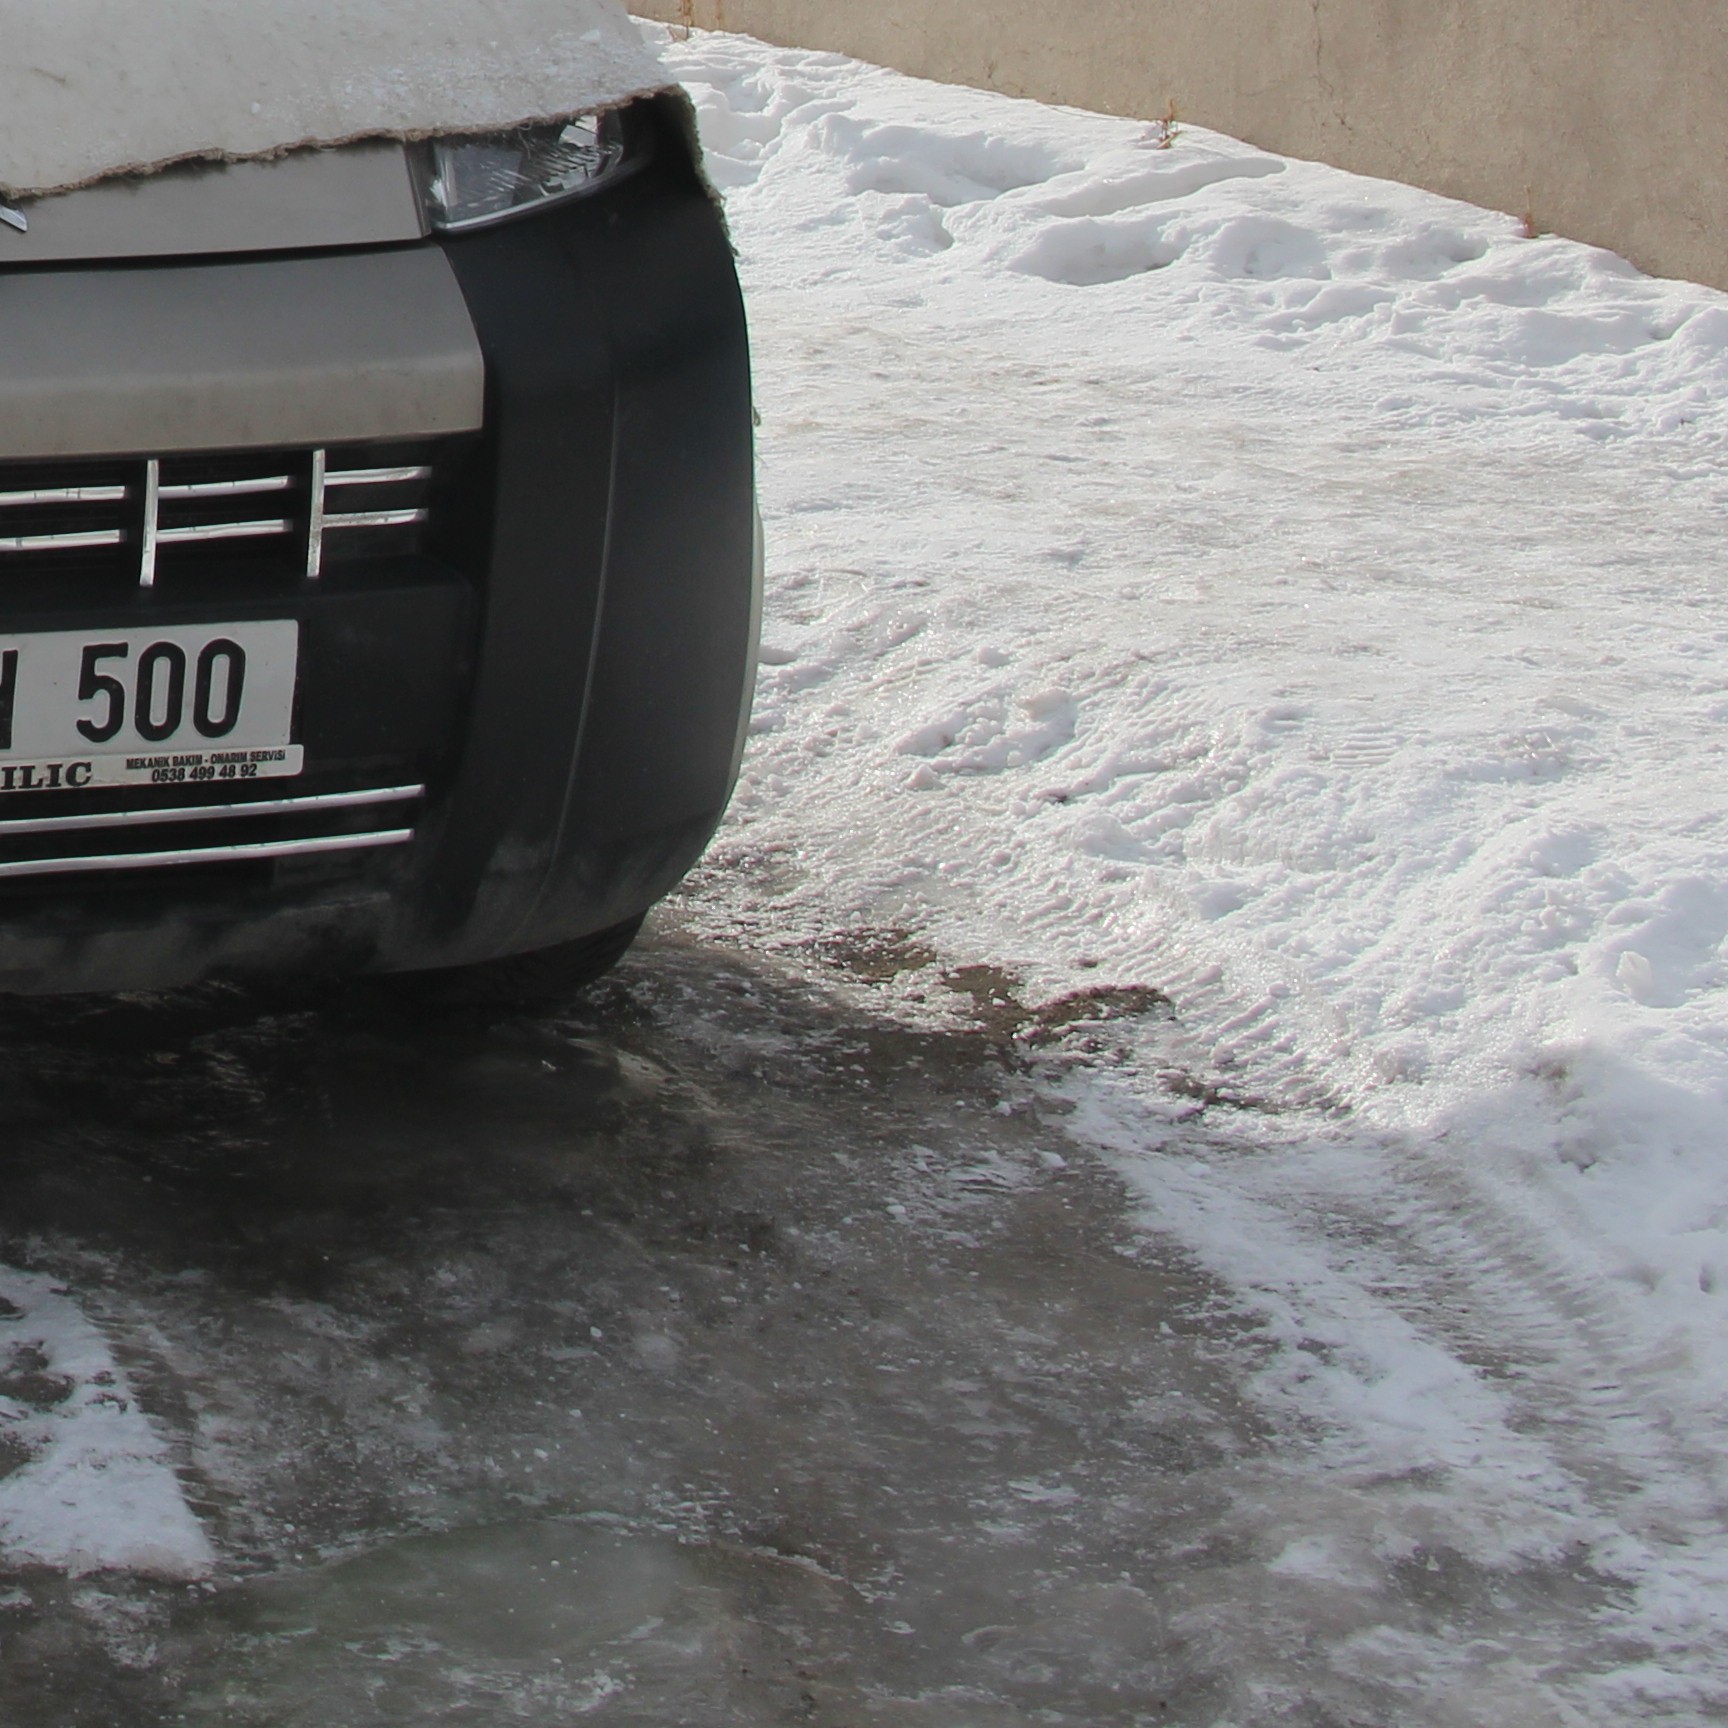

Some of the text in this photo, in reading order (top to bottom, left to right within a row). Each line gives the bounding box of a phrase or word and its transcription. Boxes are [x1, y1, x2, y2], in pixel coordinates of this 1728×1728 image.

[76, 638, 246, 743] 500
[173, 754, 203, 767] BAKIM
[210, 752, 249, 764] ONARIM
[152, 763, 258, 783] 0538 499 48 92
